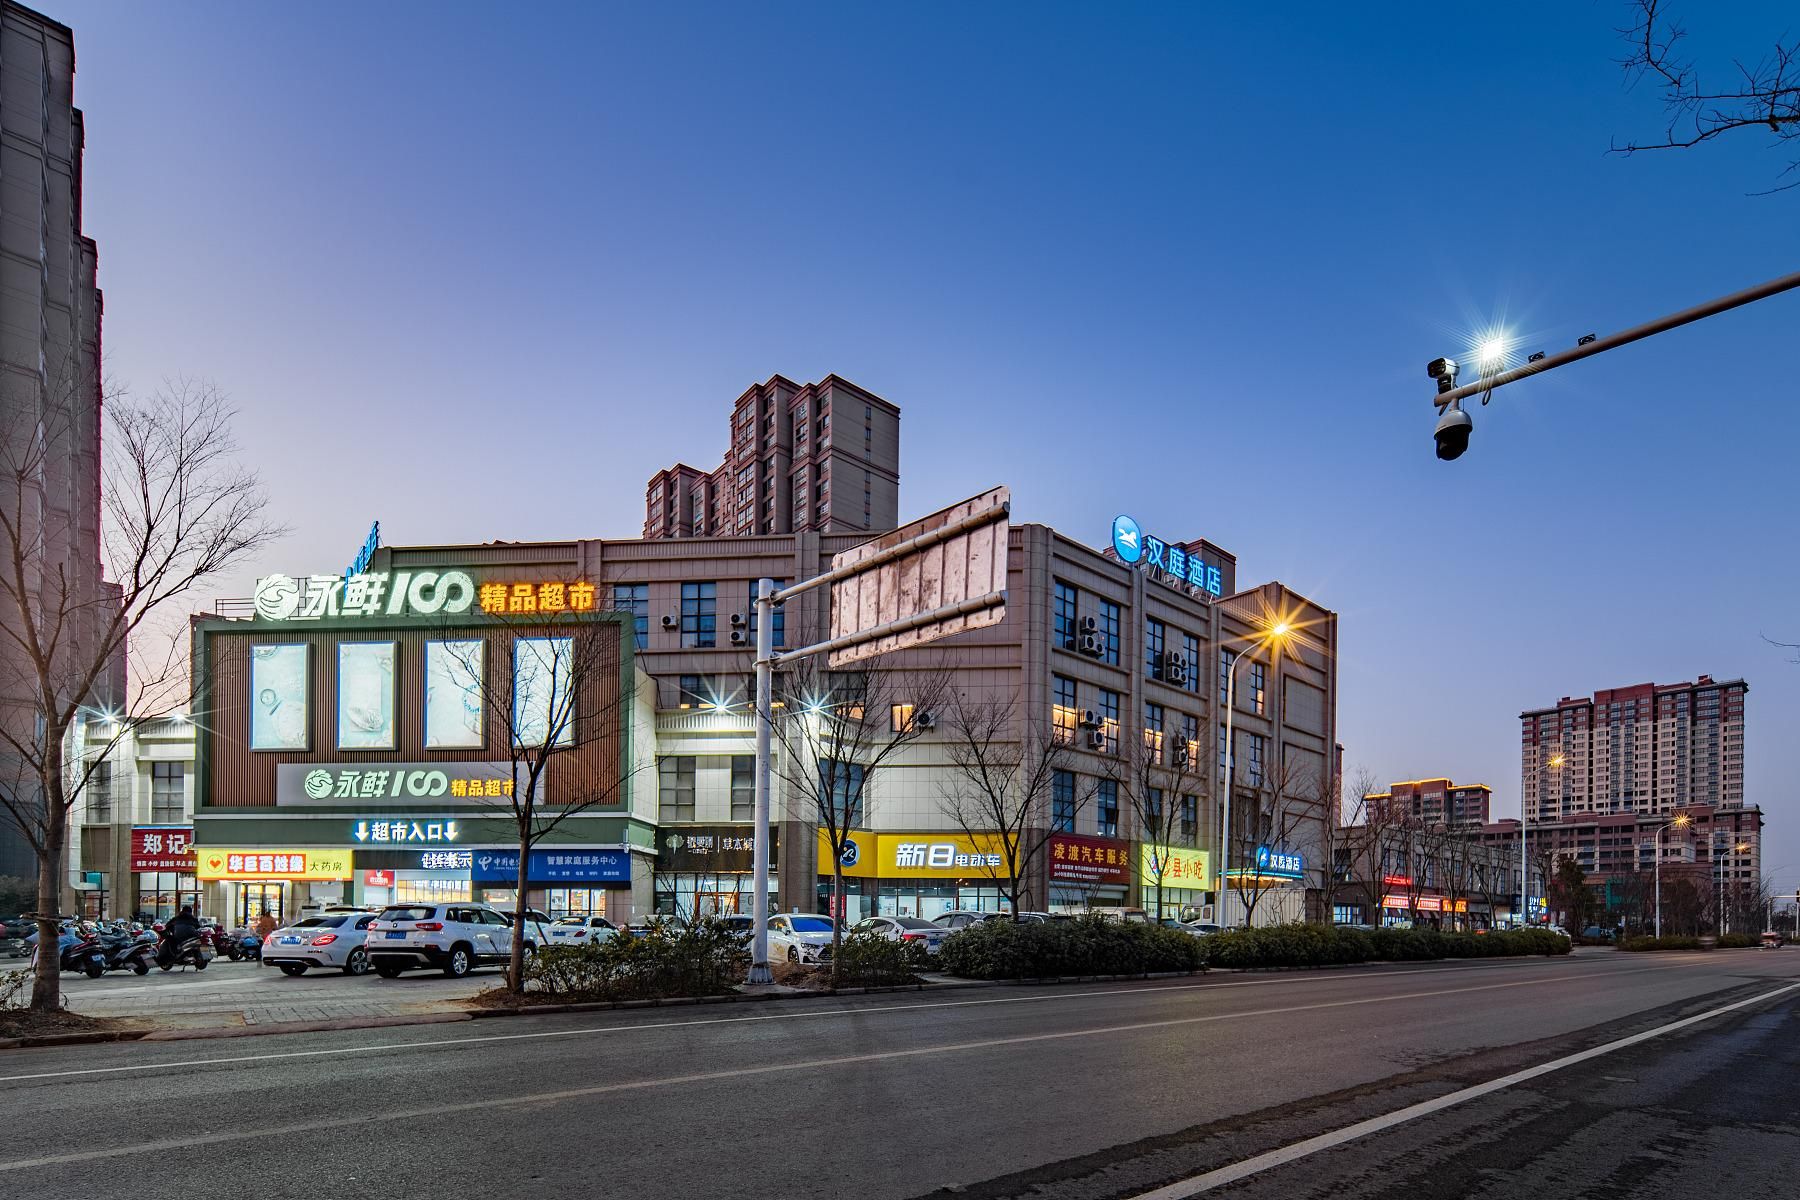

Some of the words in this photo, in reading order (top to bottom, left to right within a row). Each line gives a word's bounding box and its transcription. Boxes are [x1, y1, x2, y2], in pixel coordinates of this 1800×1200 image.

[1147, 535, 1221, 596] 汉庭酒店
[301, 571, 475, 616] 永鲜100
[480, 582, 595, 612] 精品超市
[334, 770, 448, 798] 永鲜100
[451, 779, 514, 797] 精品超市
[371, 822, 443, 841] 超市入口
[143, 834, 185, 855] 郑记
[896, 843, 955, 868] 新日
[955, 854, 1001, 868] 电动车
[1054, 843, 1129, 866] 凌渡汽车服务
[309, 861, 342, 872] 大药房
[547, 856, 617, 866] 智慧家庭服务中心
[1270, 853, 1300, 871] 汉庭酒店
